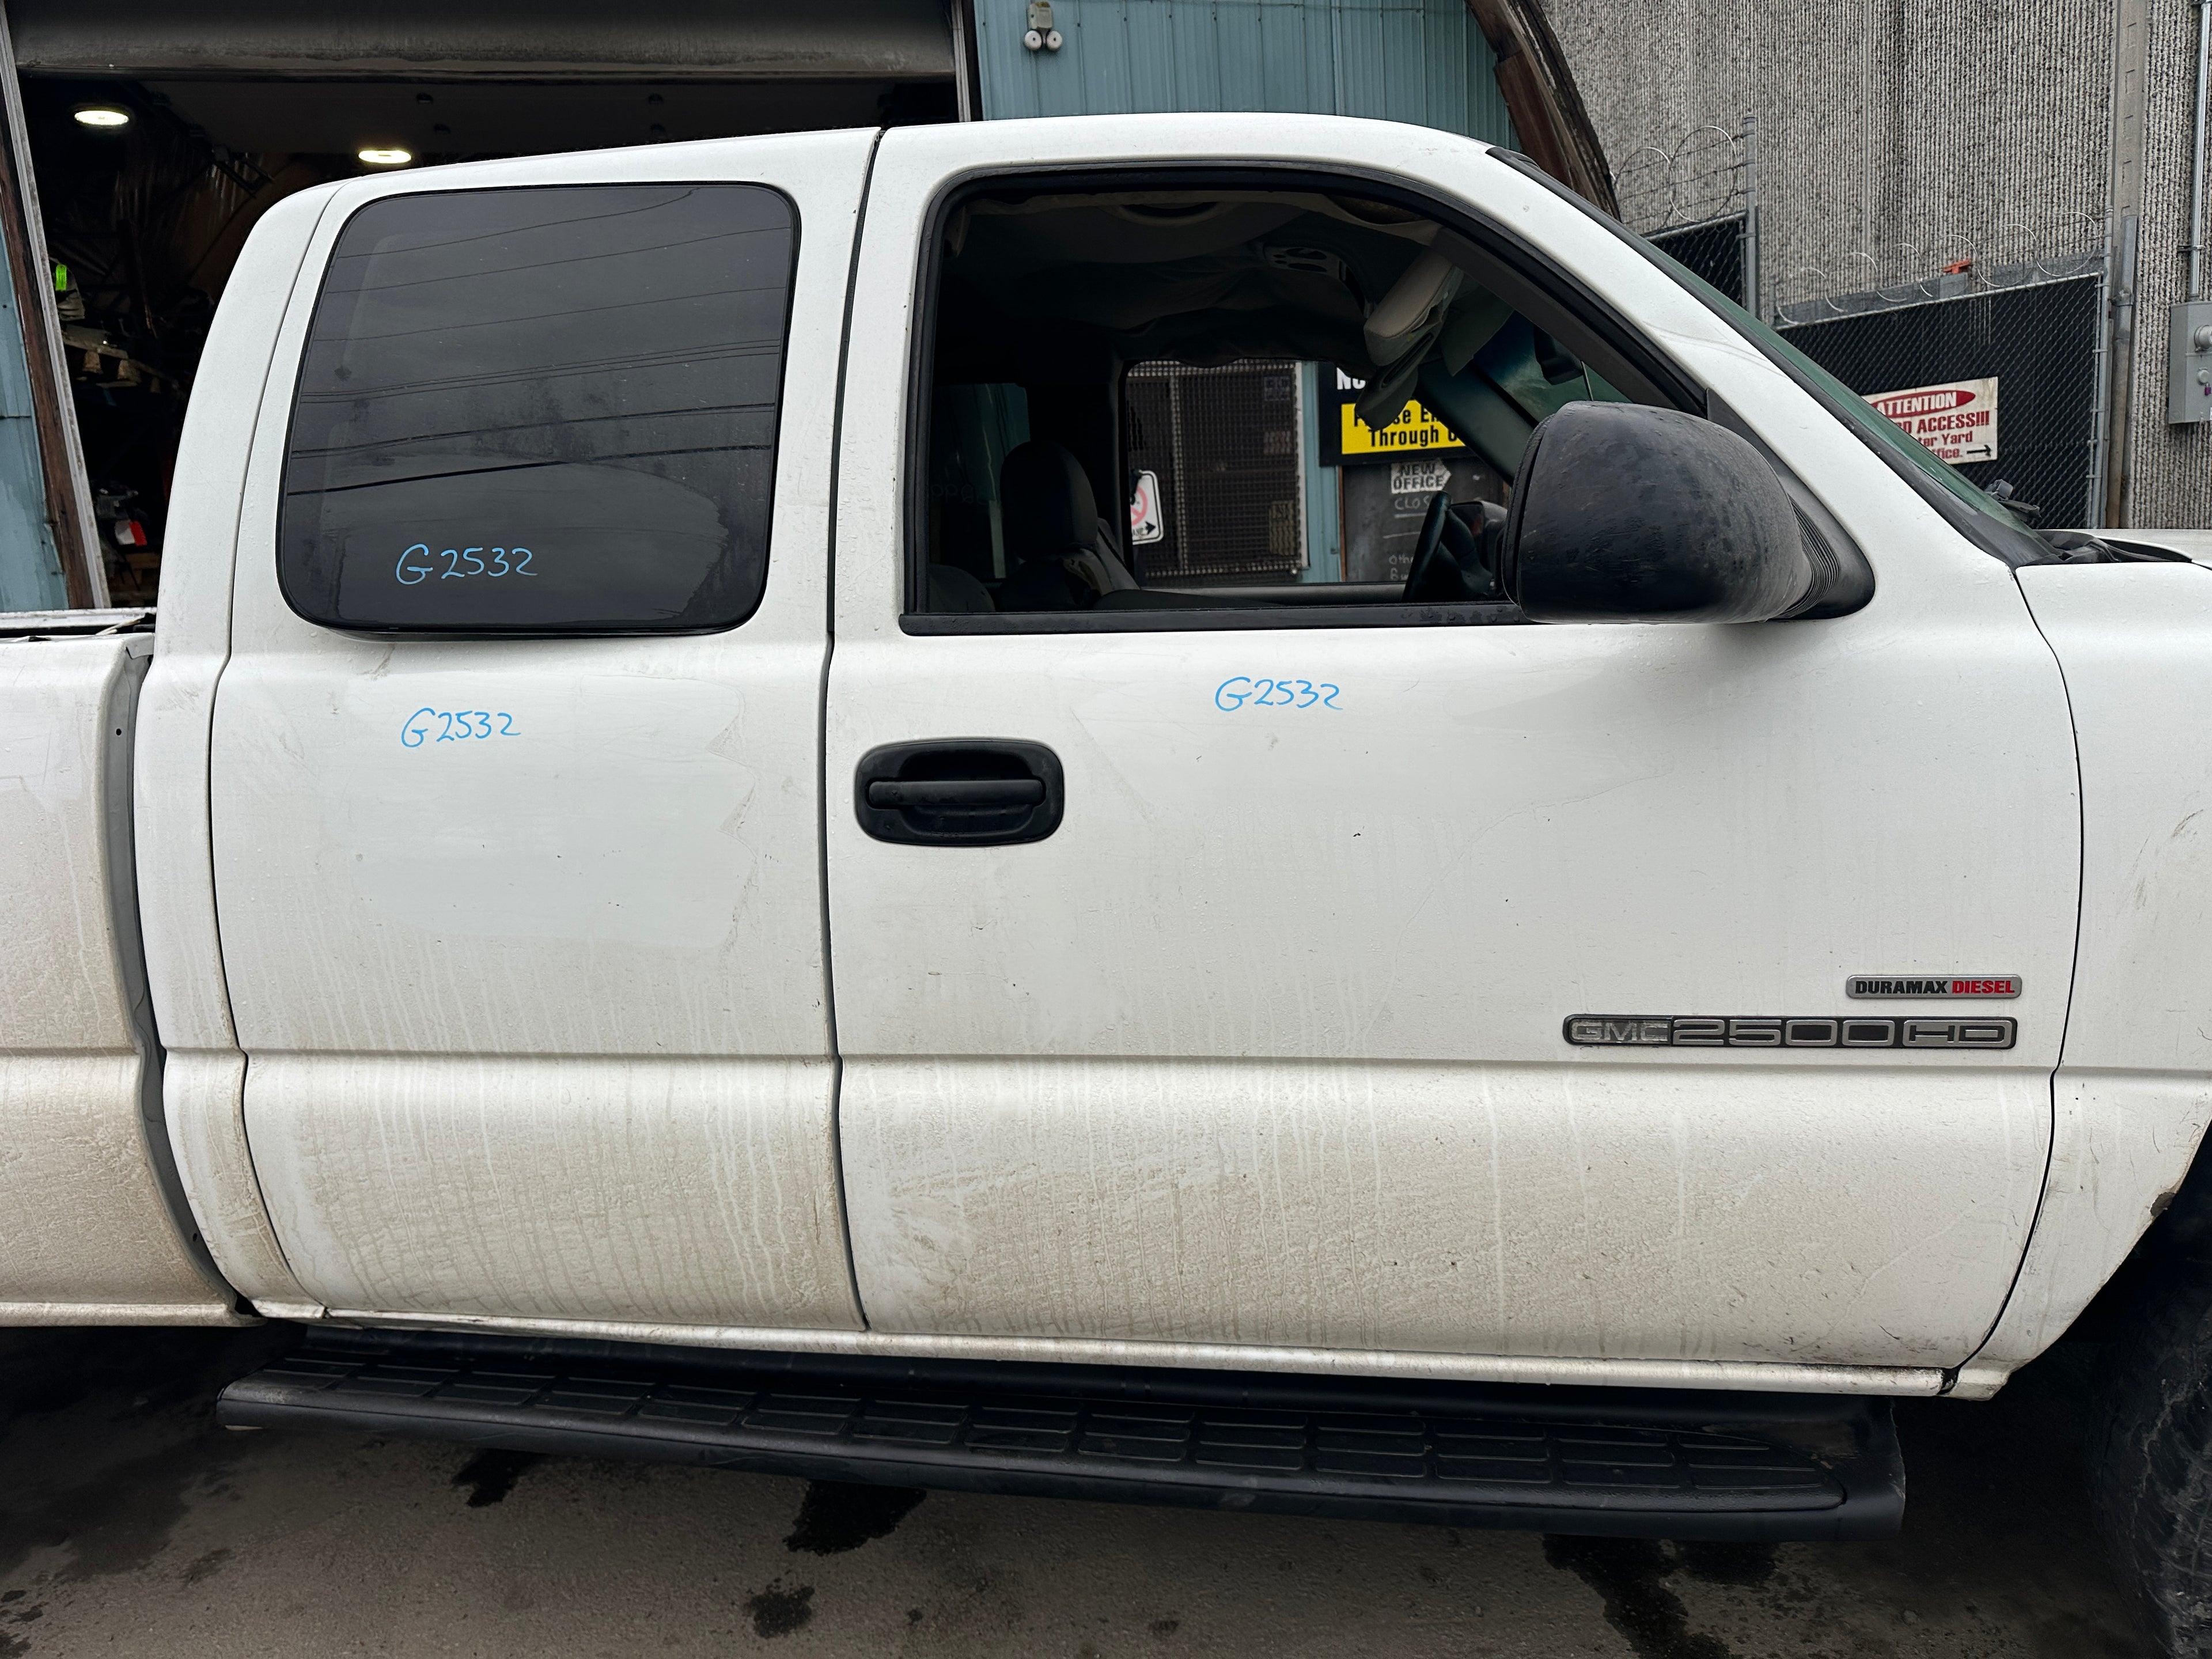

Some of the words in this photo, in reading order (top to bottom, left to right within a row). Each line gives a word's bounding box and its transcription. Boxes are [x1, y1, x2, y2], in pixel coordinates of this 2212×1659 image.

[1876, 392, 1956, 416] ATTENTION
[1368, 425, 1439, 447] Through
[1942, 430, 1973, 445] Yard
[1398, 464, 1435, 476] NEW
[1393, 475, 1444, 490] OFFICE
[396, 543, 538, 585] G2532
[1215, 676, 1343, 711] G2532
[401, 707, 521, 748] G2532
[1855, 980, 1948, 994] DURAMAX
[1952, 980, 2015, 994] DIESEL
[1571, 1020, 1669, 1043] GMC
